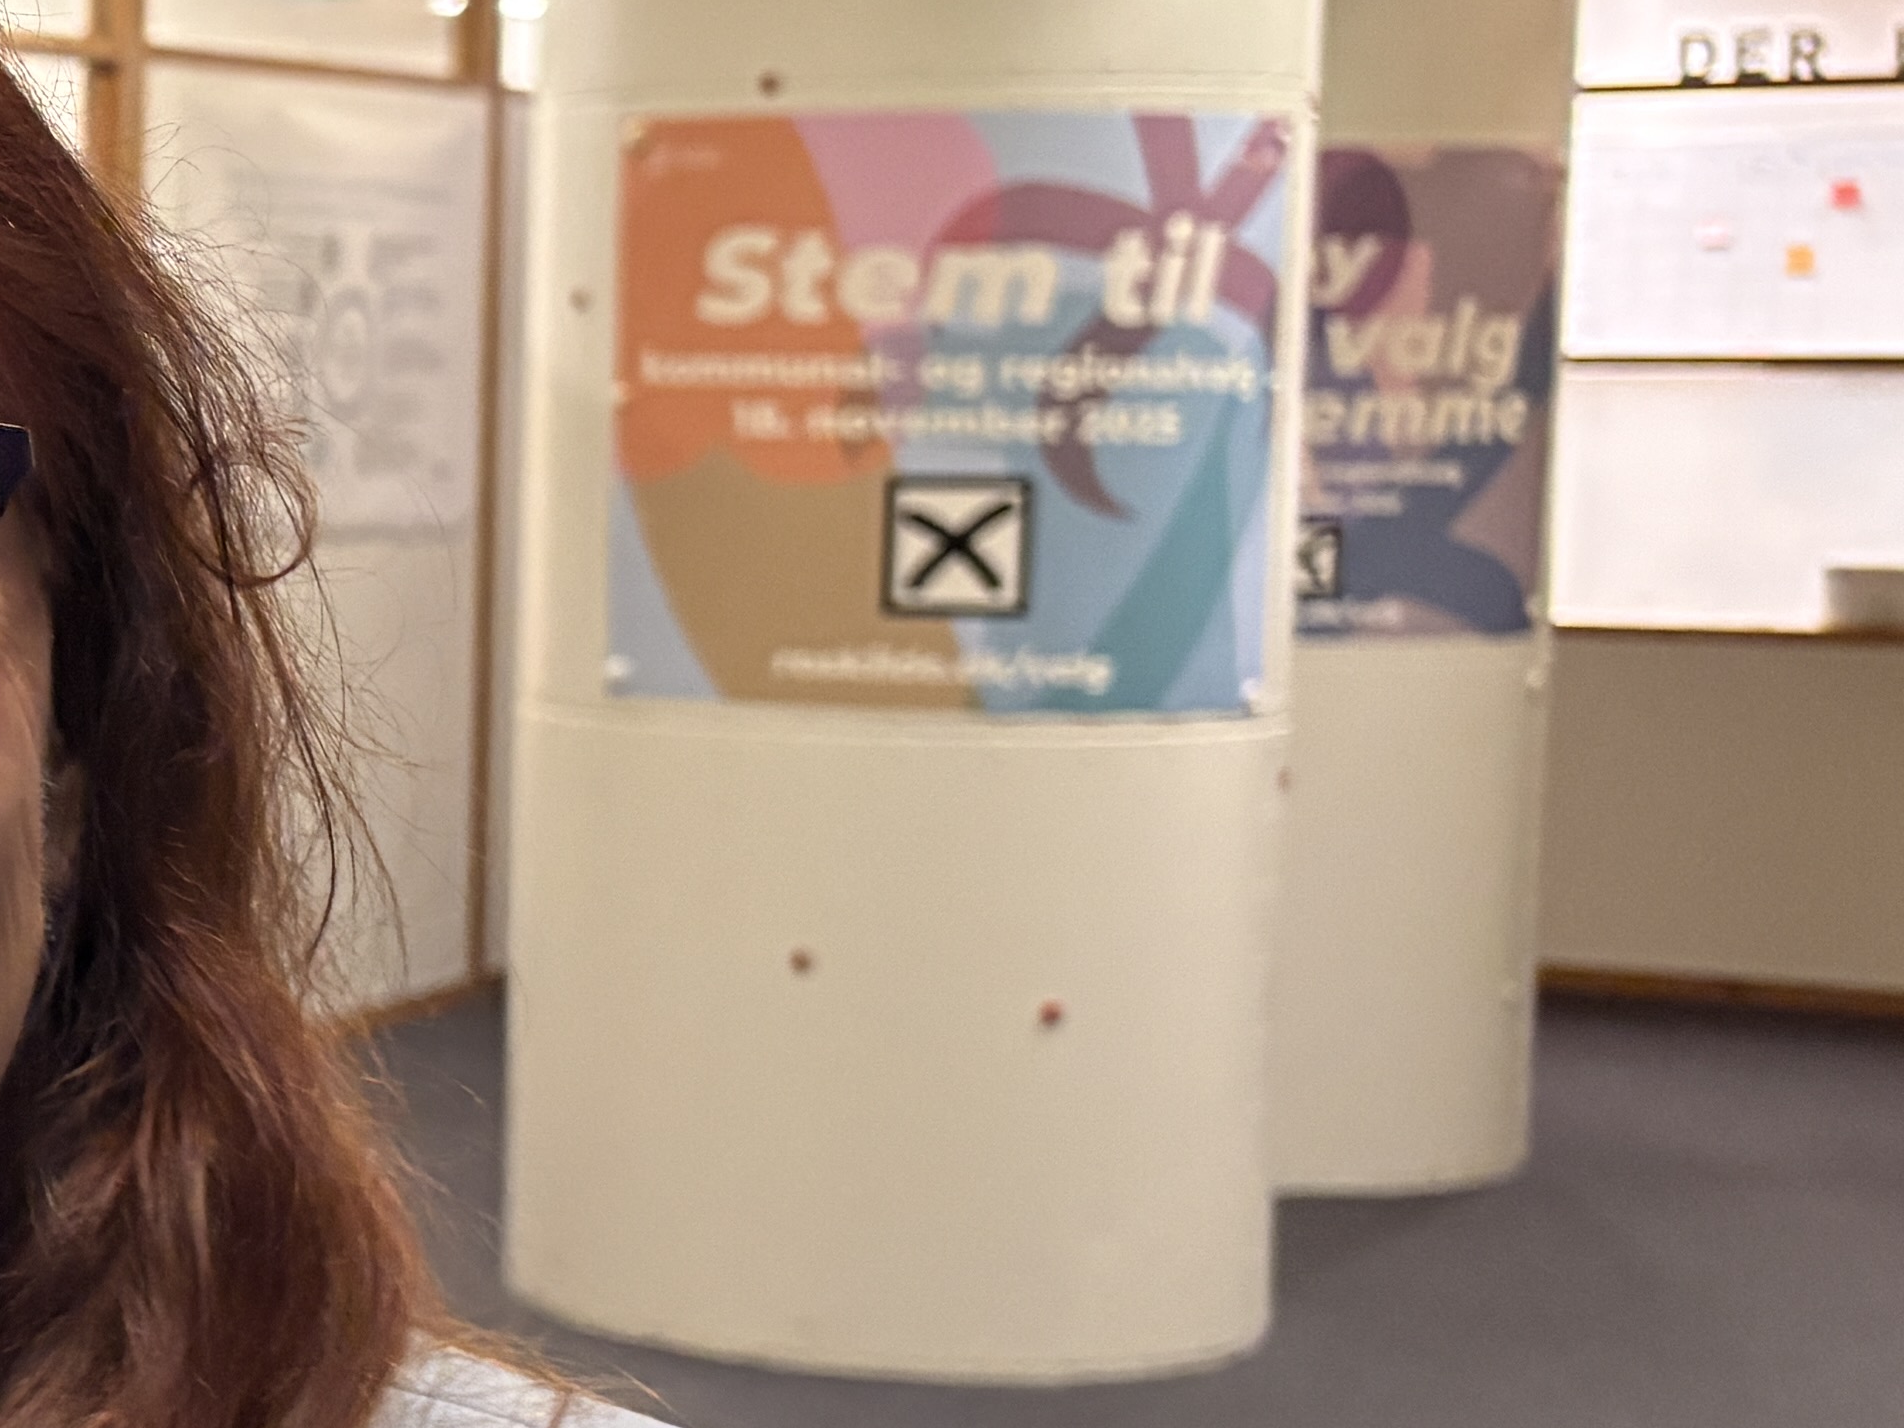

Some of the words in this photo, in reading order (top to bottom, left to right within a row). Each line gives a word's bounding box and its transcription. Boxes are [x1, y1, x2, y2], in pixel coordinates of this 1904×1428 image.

[1679, 26, 1827, 87] DER
[695, 222, 1060, 326] Stem
[1102, 211, 1229, 327] til
[1308, 233, 1382, 309] y
[920, 354, 985, 400] og
[1324, 295, 1519, 391] valg
[1303, 390, 1528, 446] emme
